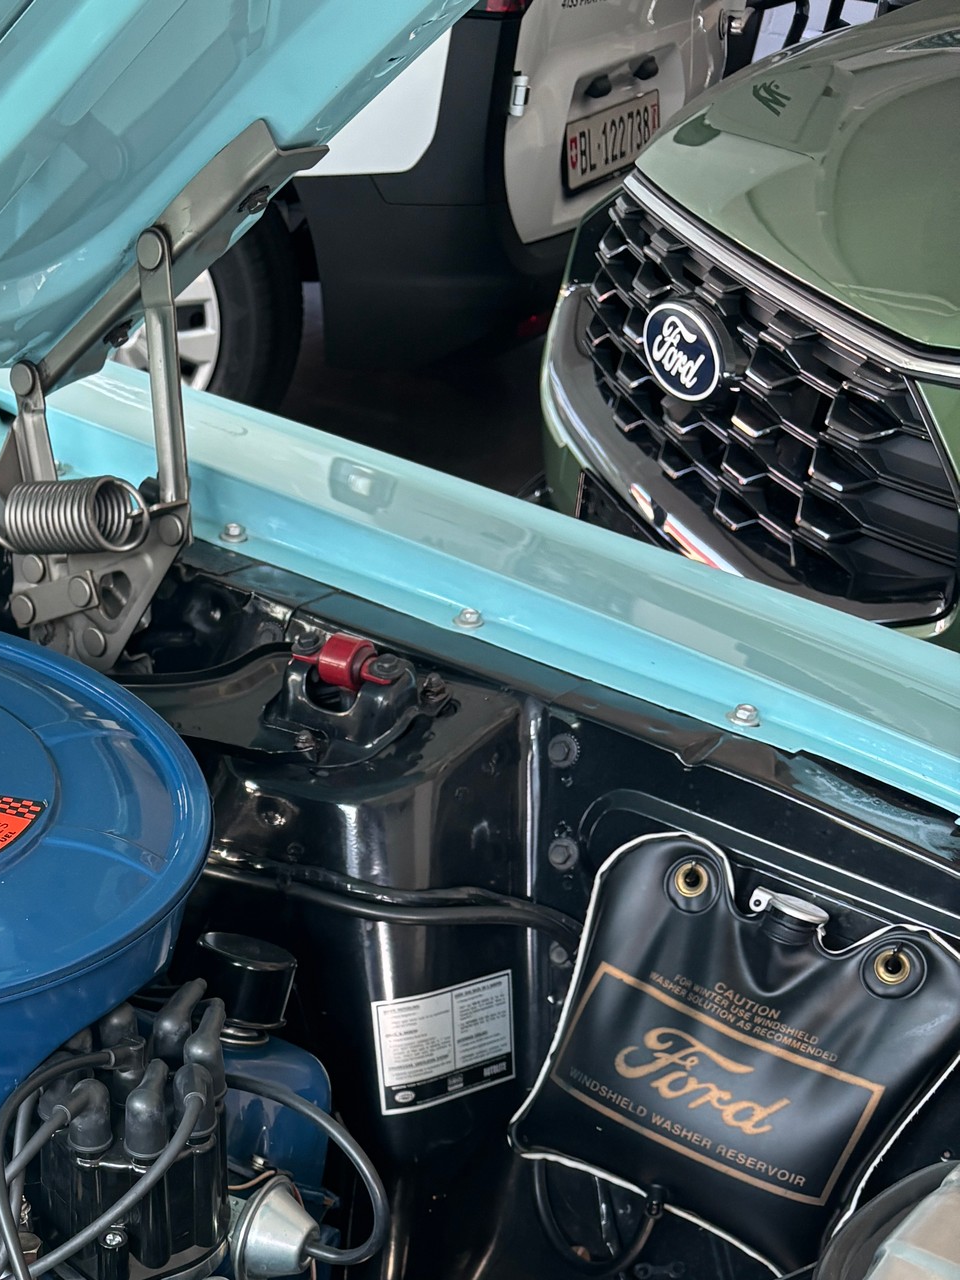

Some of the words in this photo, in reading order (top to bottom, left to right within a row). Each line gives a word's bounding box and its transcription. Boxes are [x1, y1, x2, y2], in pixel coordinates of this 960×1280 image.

[652, 316, 705, 389] Ford
[649, 971, 687, 997] WASHER
[686, 993, 737, 1022] SOLUTION
[736, 1019, 753, 1033] AS
[753, 1024, 838, 1063] RECOMMENDED
[674, 973, 692, 987] FOR
[692, 983, 729, 1008] WINTER
[730, 1002, 753, 1020] USE
[753, 1012, 820, 1045] WINDSHIELD
[713, 981, 781, 1019] CAUTION
[614, 1027, 791, 1136] Ford
[569, 1066, 648, 1118] WINDSHIELD
[650, 1113, 712, 1150] WASHER
[716, 1145, 807, 1187] RESERVOIR
